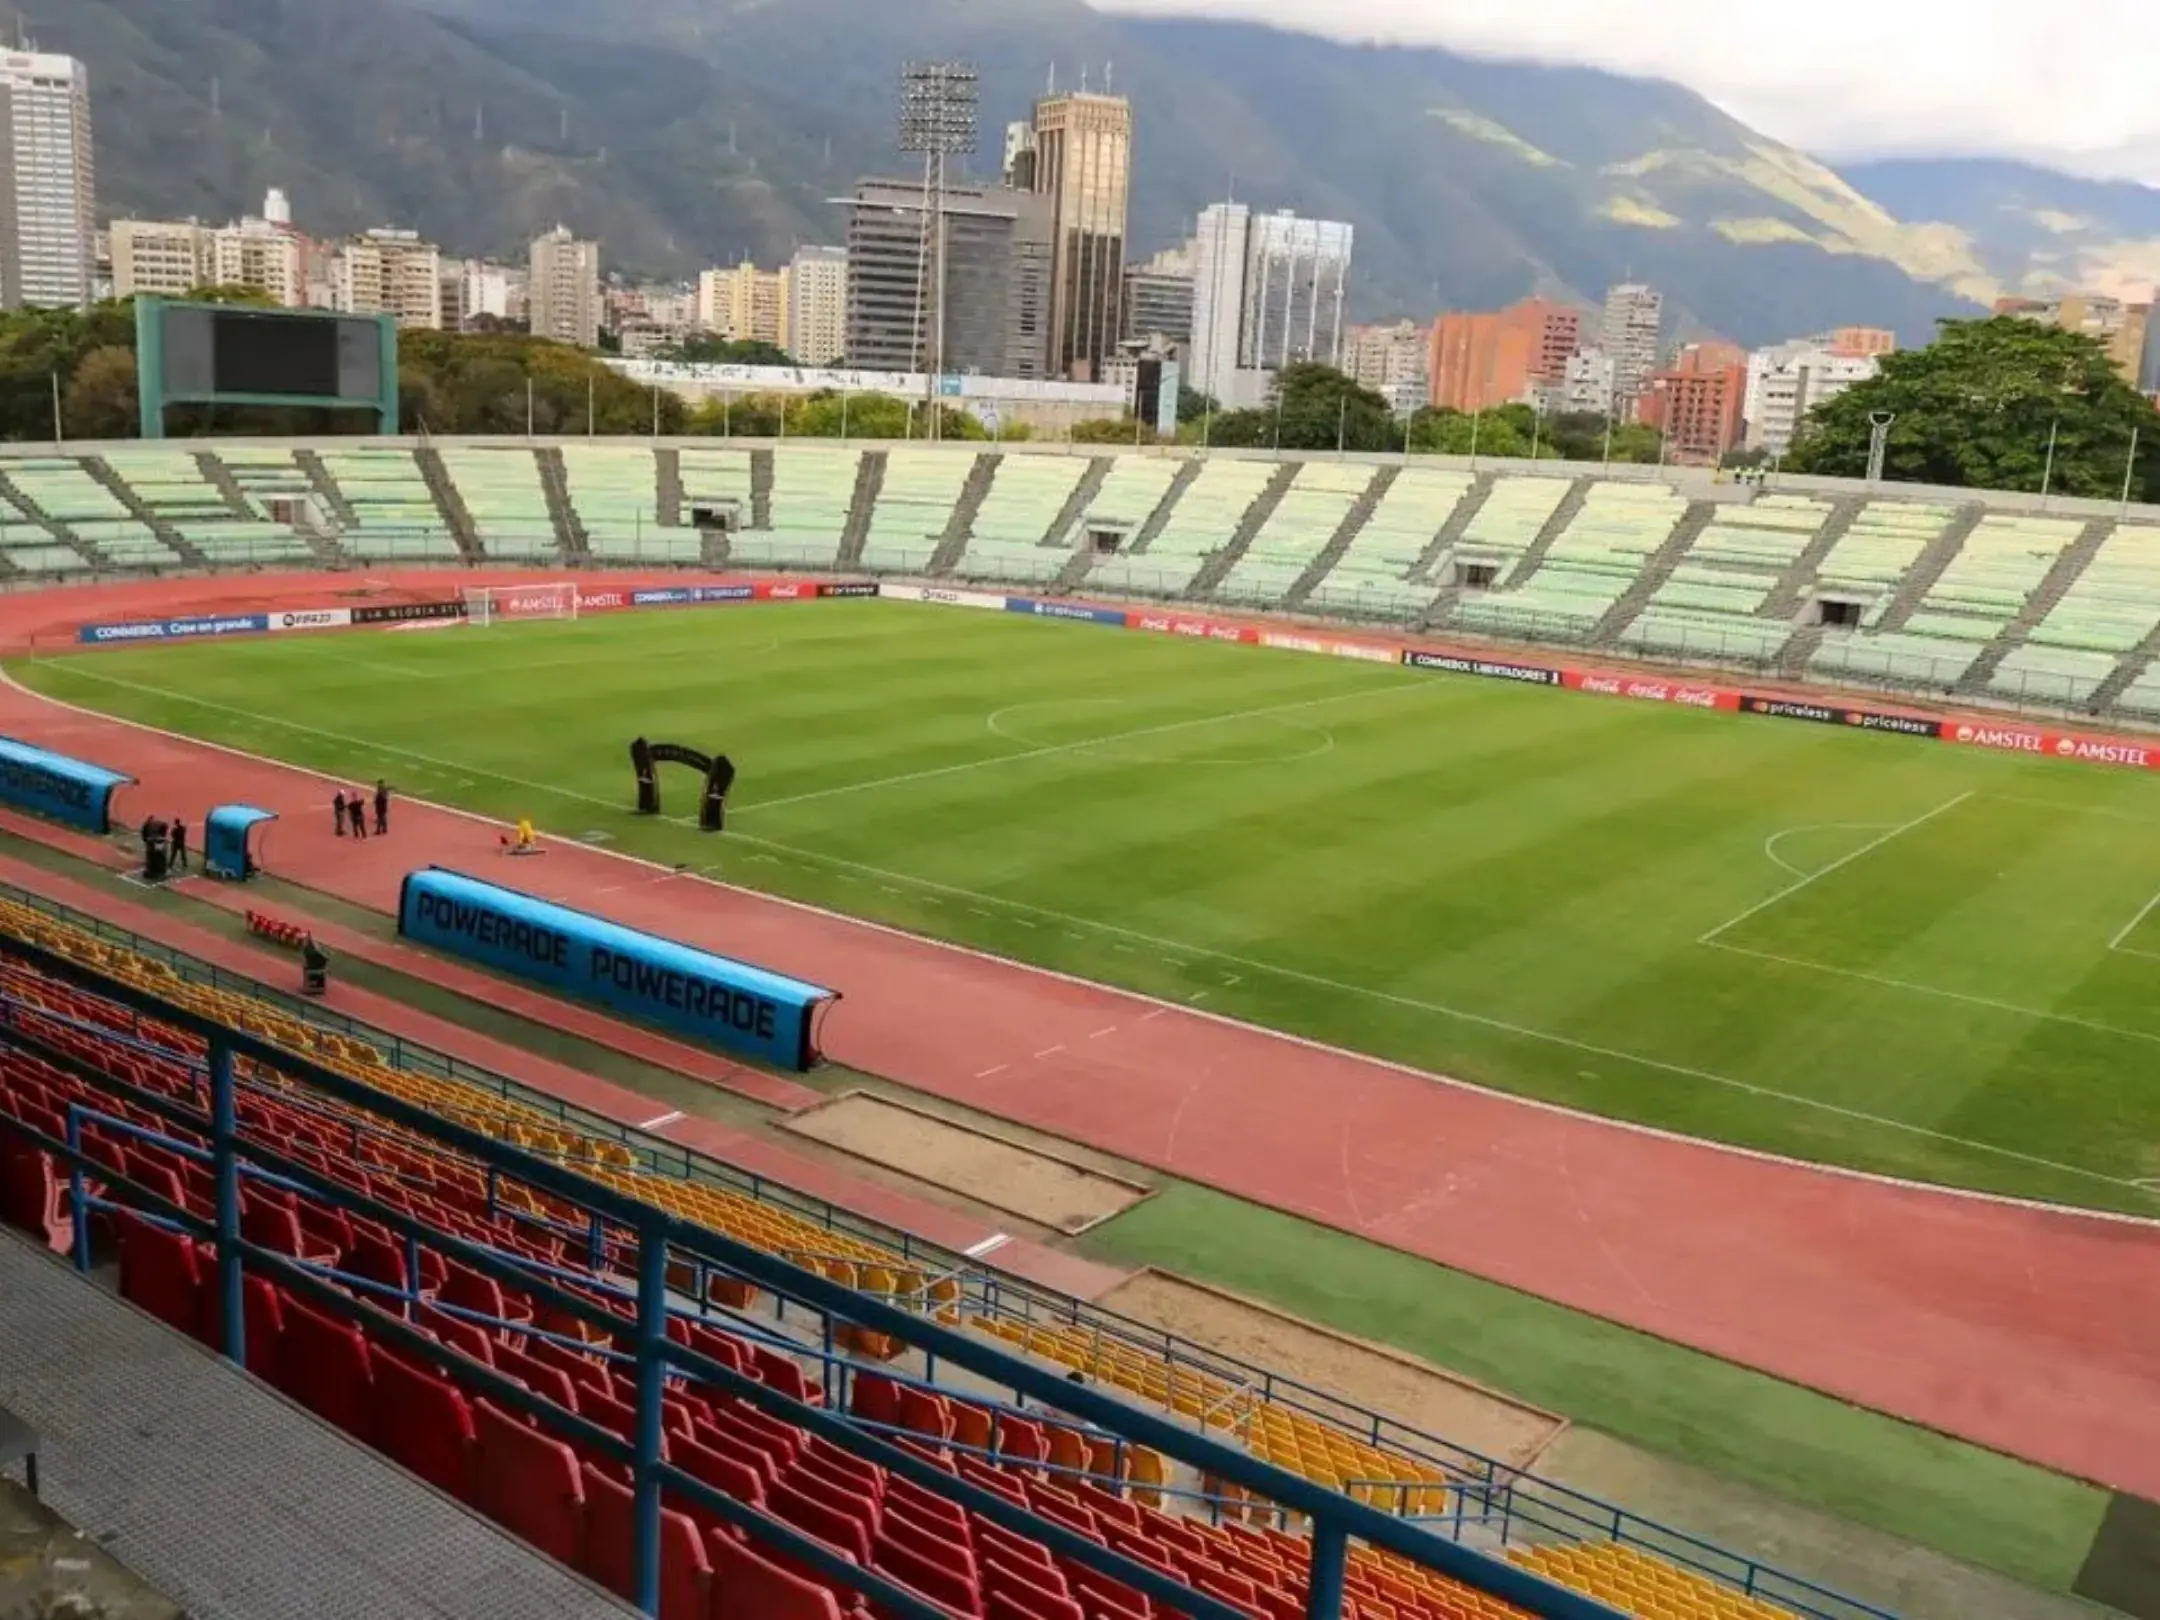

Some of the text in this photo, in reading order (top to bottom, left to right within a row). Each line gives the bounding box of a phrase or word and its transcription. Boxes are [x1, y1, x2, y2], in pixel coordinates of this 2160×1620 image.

[522, 596, 564, 612] AMSTEL
[581, 594, 623, 607] AMSTEL
[1416, 654, 1547, 682] CONMEBOL LIBERTADORES
[1769, 703, 1929, 733] priceless priceless
[1974, 728, 2149, 766] AMSTEL AMSTEL
[416, 890, 777, 1040] POWERADE POWERADE
